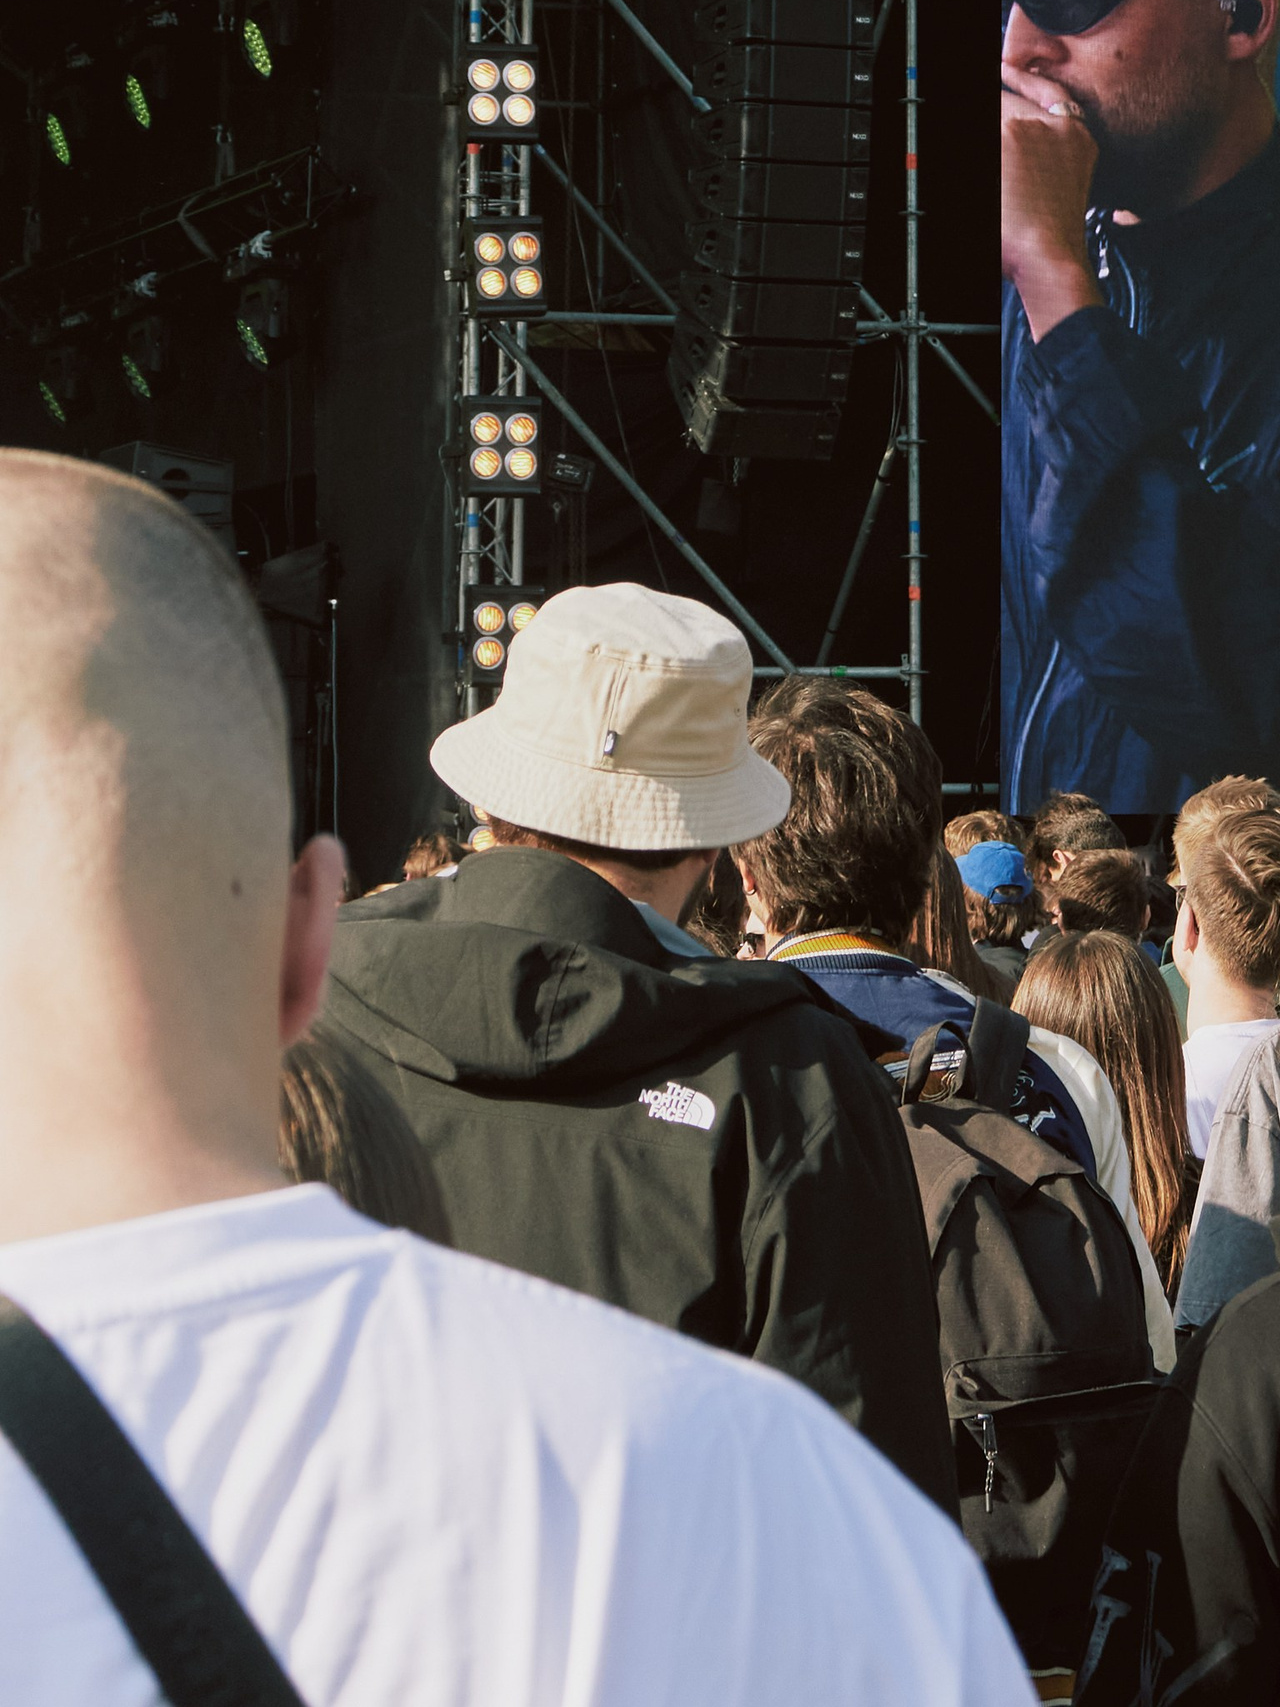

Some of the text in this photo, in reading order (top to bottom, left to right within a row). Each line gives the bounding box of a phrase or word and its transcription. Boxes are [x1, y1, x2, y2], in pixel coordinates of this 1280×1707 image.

[638, 1088, 690, 1110] NORTH
[667, 1081, 695, 1099] THE
[648, 1103, 686, 1122] FACE
